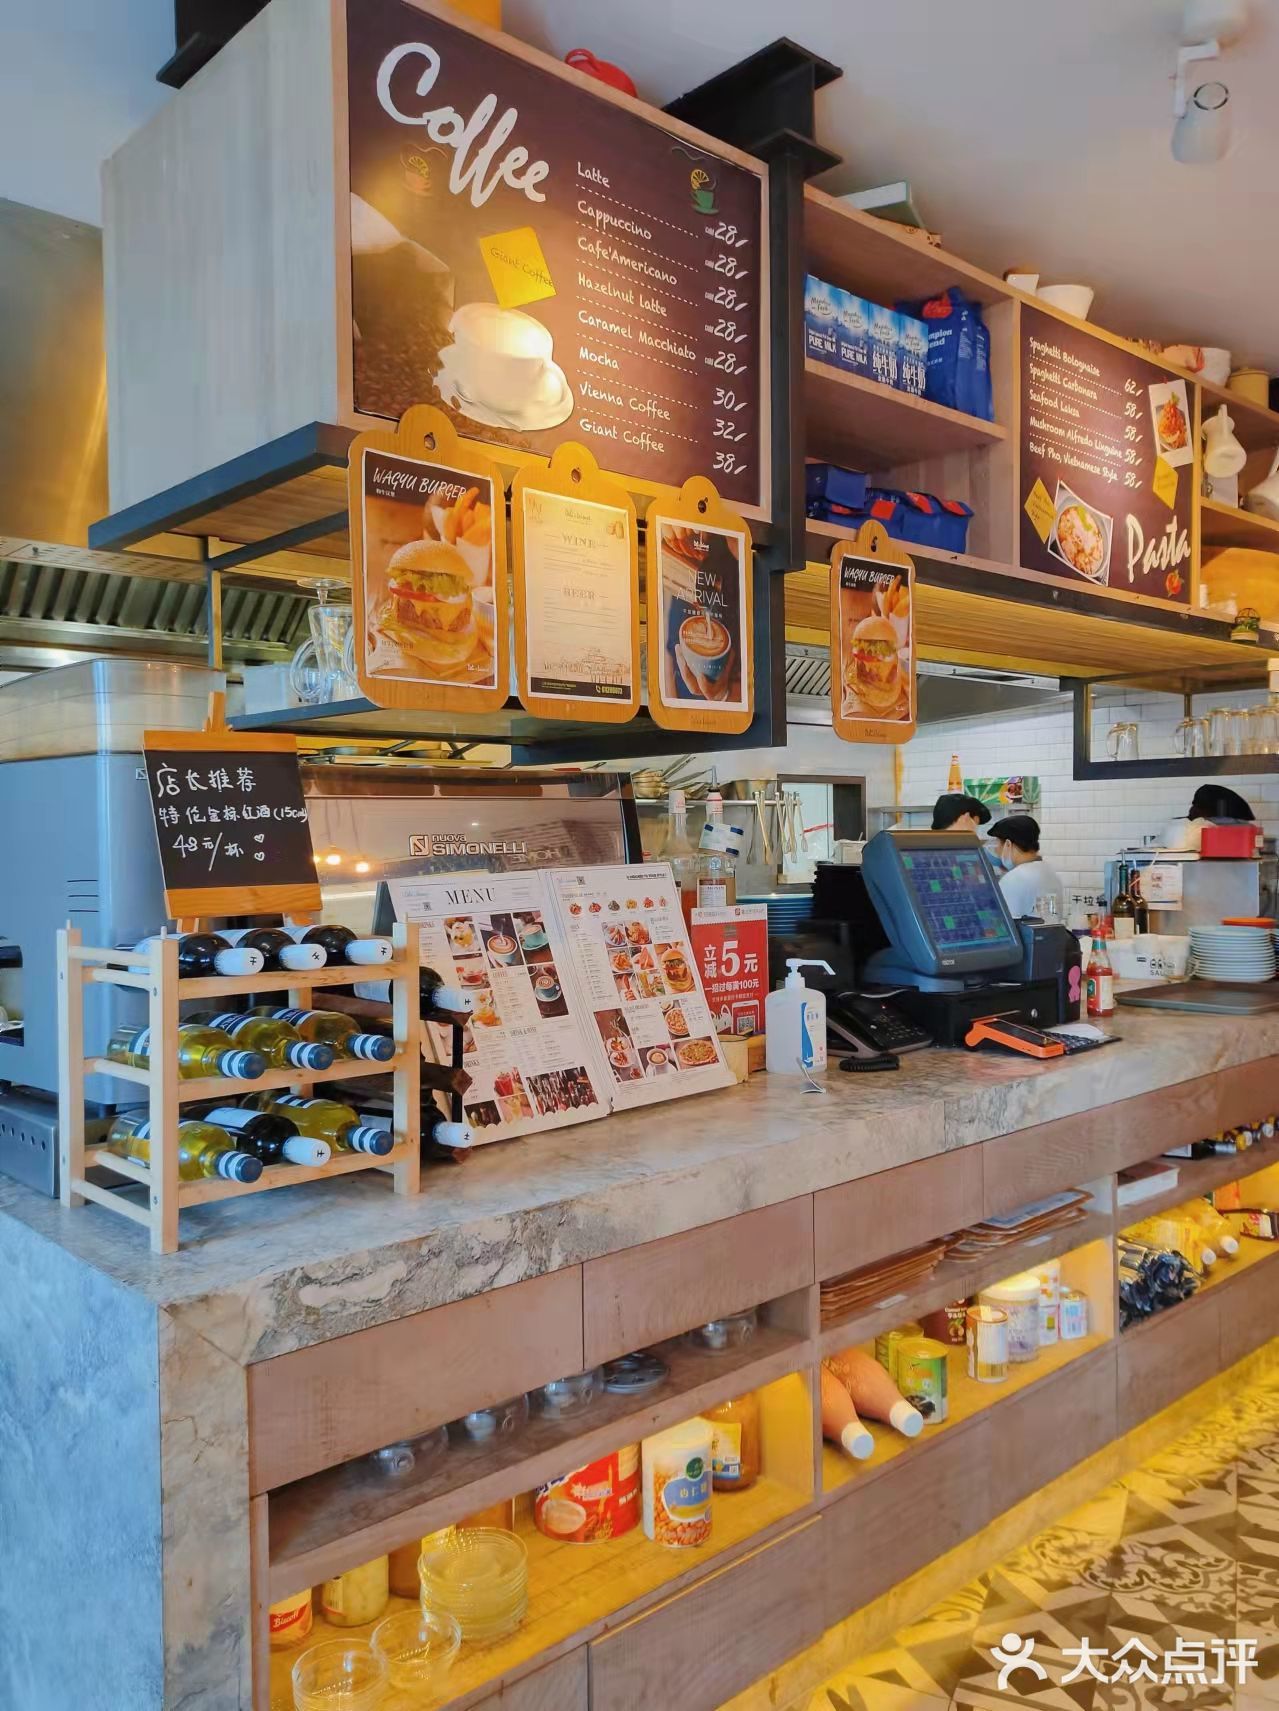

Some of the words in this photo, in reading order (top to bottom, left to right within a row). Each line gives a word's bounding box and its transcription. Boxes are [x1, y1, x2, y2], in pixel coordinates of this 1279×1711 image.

[377, 42, 550, 208] Coffee
[578, 161, 611, 188] Latte
[577, 200, 652, 240] Cappuccino
[577, 272, 635, 304] Hazelnut
[578, 310, 633, 339] Caramel
[638, 331, 697, 361] Macchiato
[808, 334, 823, 349] PURE
[824, 339, 837, 354] MILK
[928, 328, 953, 340] mpion
[579, 346, 620, 370] Mocha
[841, 346, 856, 361] PURE
[856, 351, 868, 366] MILK
[1029, 336, 1061, 360] Spaghetti
[872, 350, 898, 380] 纯牛奶
[902, 361, 926, 391] 纯牛奶
[1029, 362, 1061, 385] Spaghetti
[1062, 377, 1098, 401] Carbonara
[579, 381, 624, 406] Vienna
[629, 397, 671, 421] Coffee
[1029, 388, 1059, 409] Seafood
[579, 418, 618, 440] Giant
[623, 430, 665, 453] Coffee
[1066, 429, 1094, 447] Alfredo
[1029, 441, 1046, 458] Beef
[1063, 452, 1101, 475] Vietnamese
[373, 467, 418, 490] WAGYU
[418, 477, 467, 501] BURGER
[1125, 513, 1191, 584] Pasta
[688, 569, 717, 587] NEW
[844, 566, 869, 582] WAGYU
[868, 570, 895, 585] BURGER
[432, 833, 467, 842] nuova
[432, 841, 527, 856] SIMONELLI
[444, 887, 497, 905] MENU
